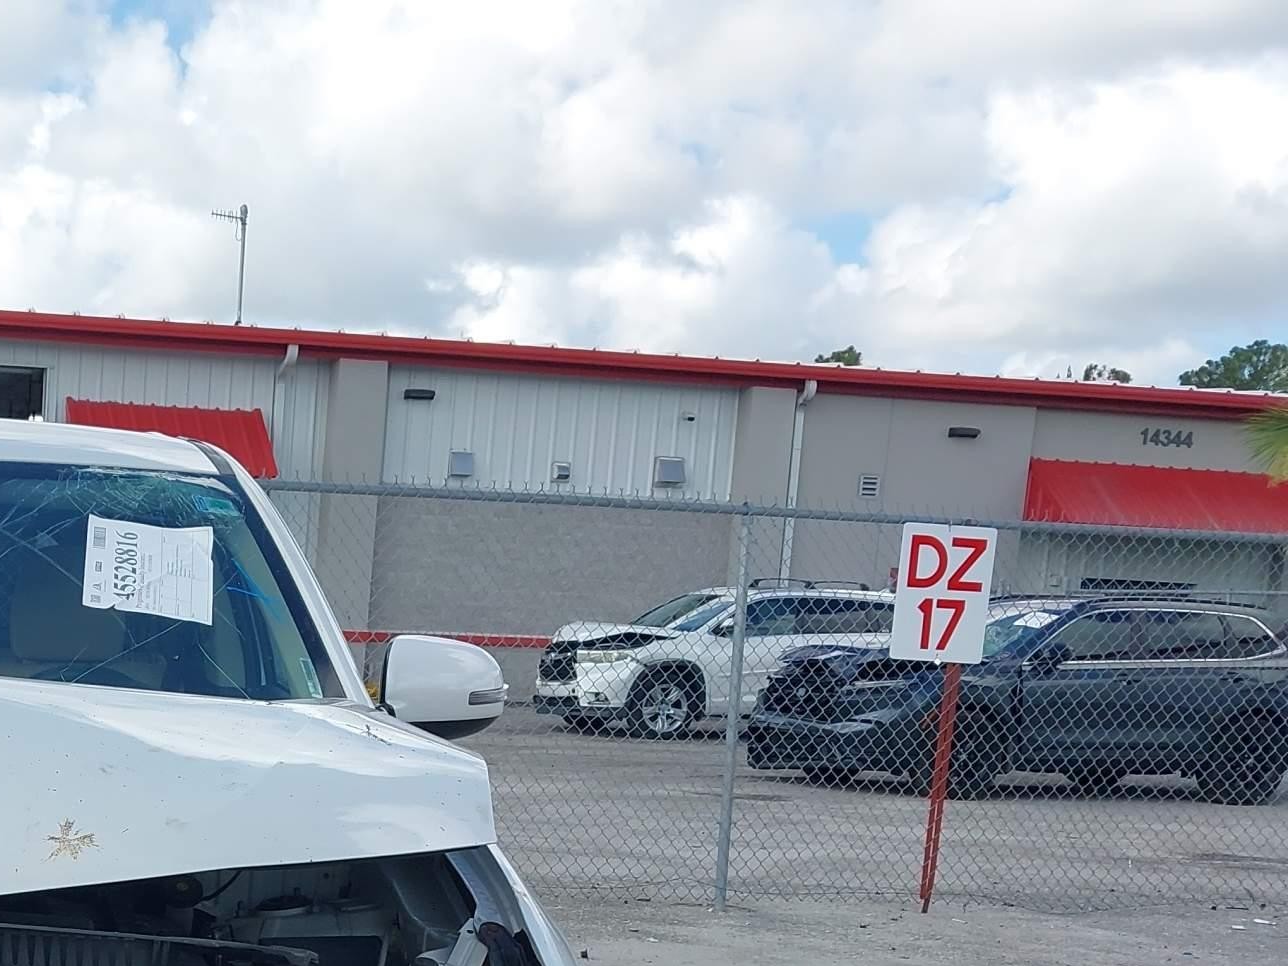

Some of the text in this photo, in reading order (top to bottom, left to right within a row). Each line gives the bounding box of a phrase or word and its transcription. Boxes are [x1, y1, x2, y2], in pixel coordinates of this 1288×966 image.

[1140, 427, 1193, 448] 14344
[113, 528, 139, 601] 45528816
[907, 534, 988, 592] DZ
[917, 598, 966, 651] 17
